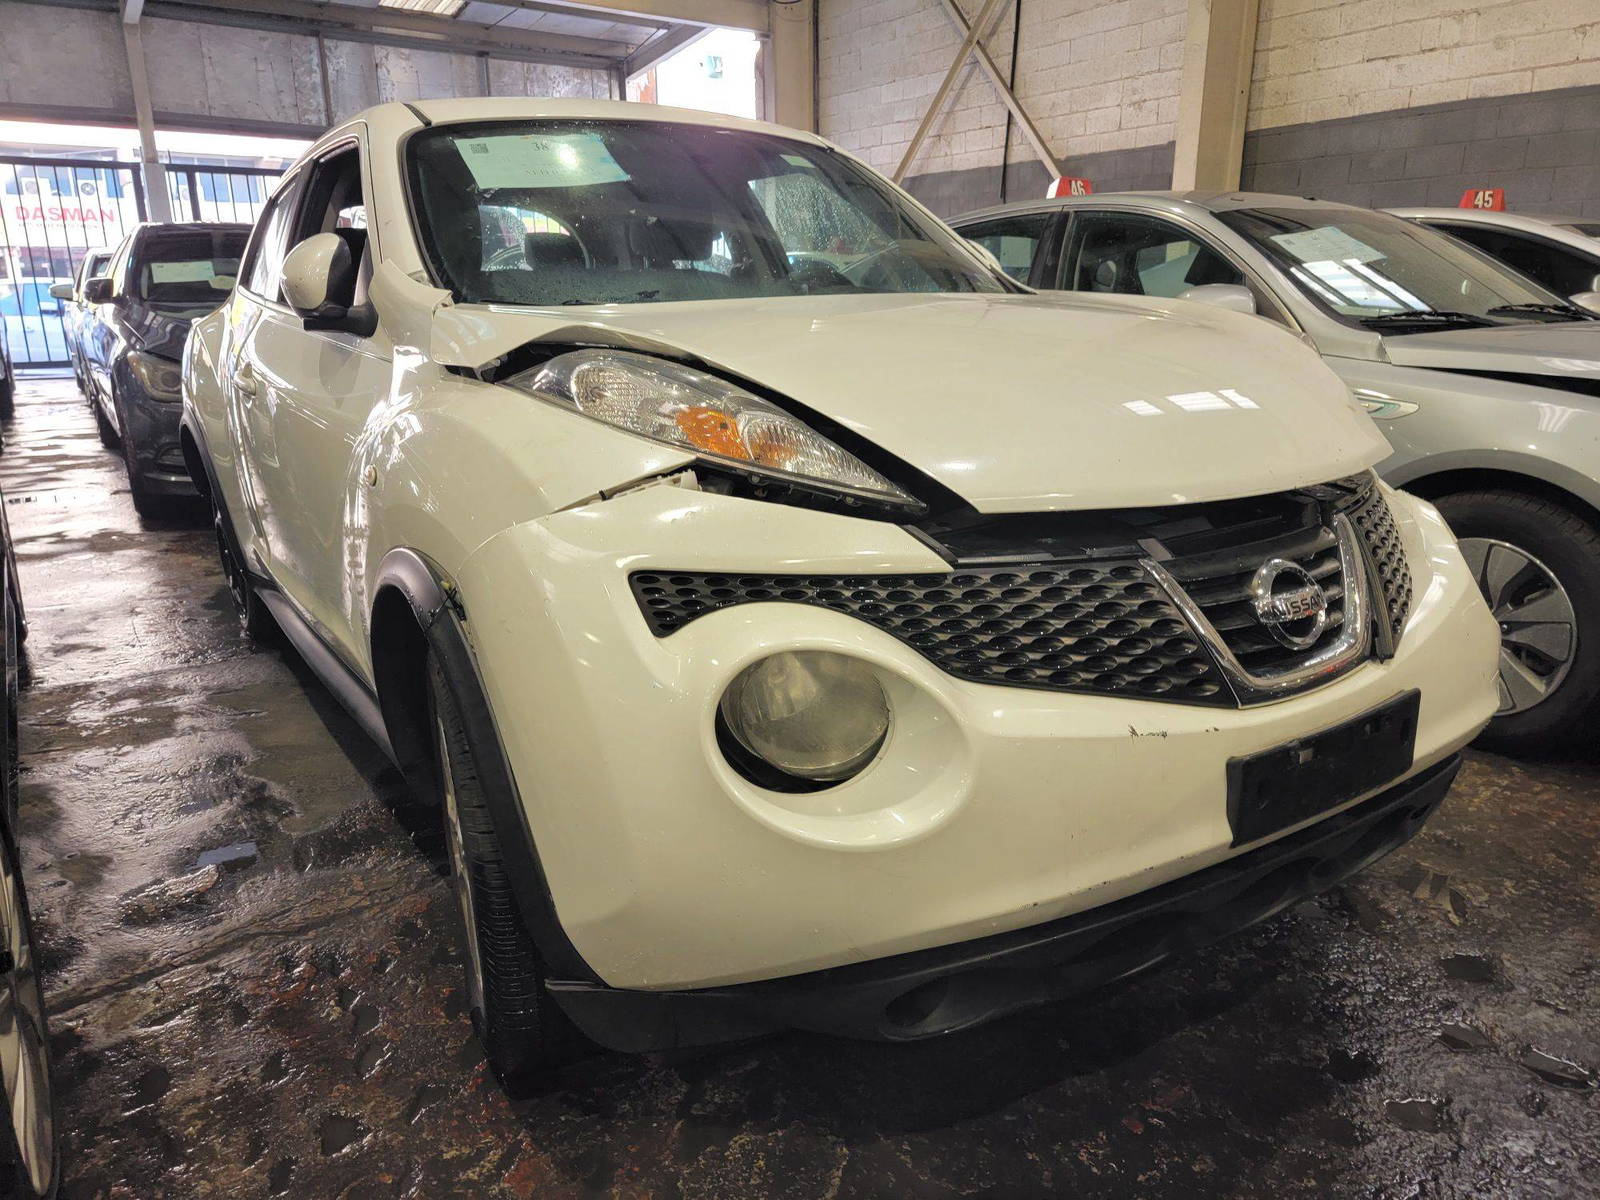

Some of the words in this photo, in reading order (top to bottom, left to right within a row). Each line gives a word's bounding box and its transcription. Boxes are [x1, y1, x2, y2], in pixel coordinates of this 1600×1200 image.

[1070, 179, 1086, 197] 46
[1473, 190, 1494, 209] 45
[15, 206, 115, 222] DASMAN
